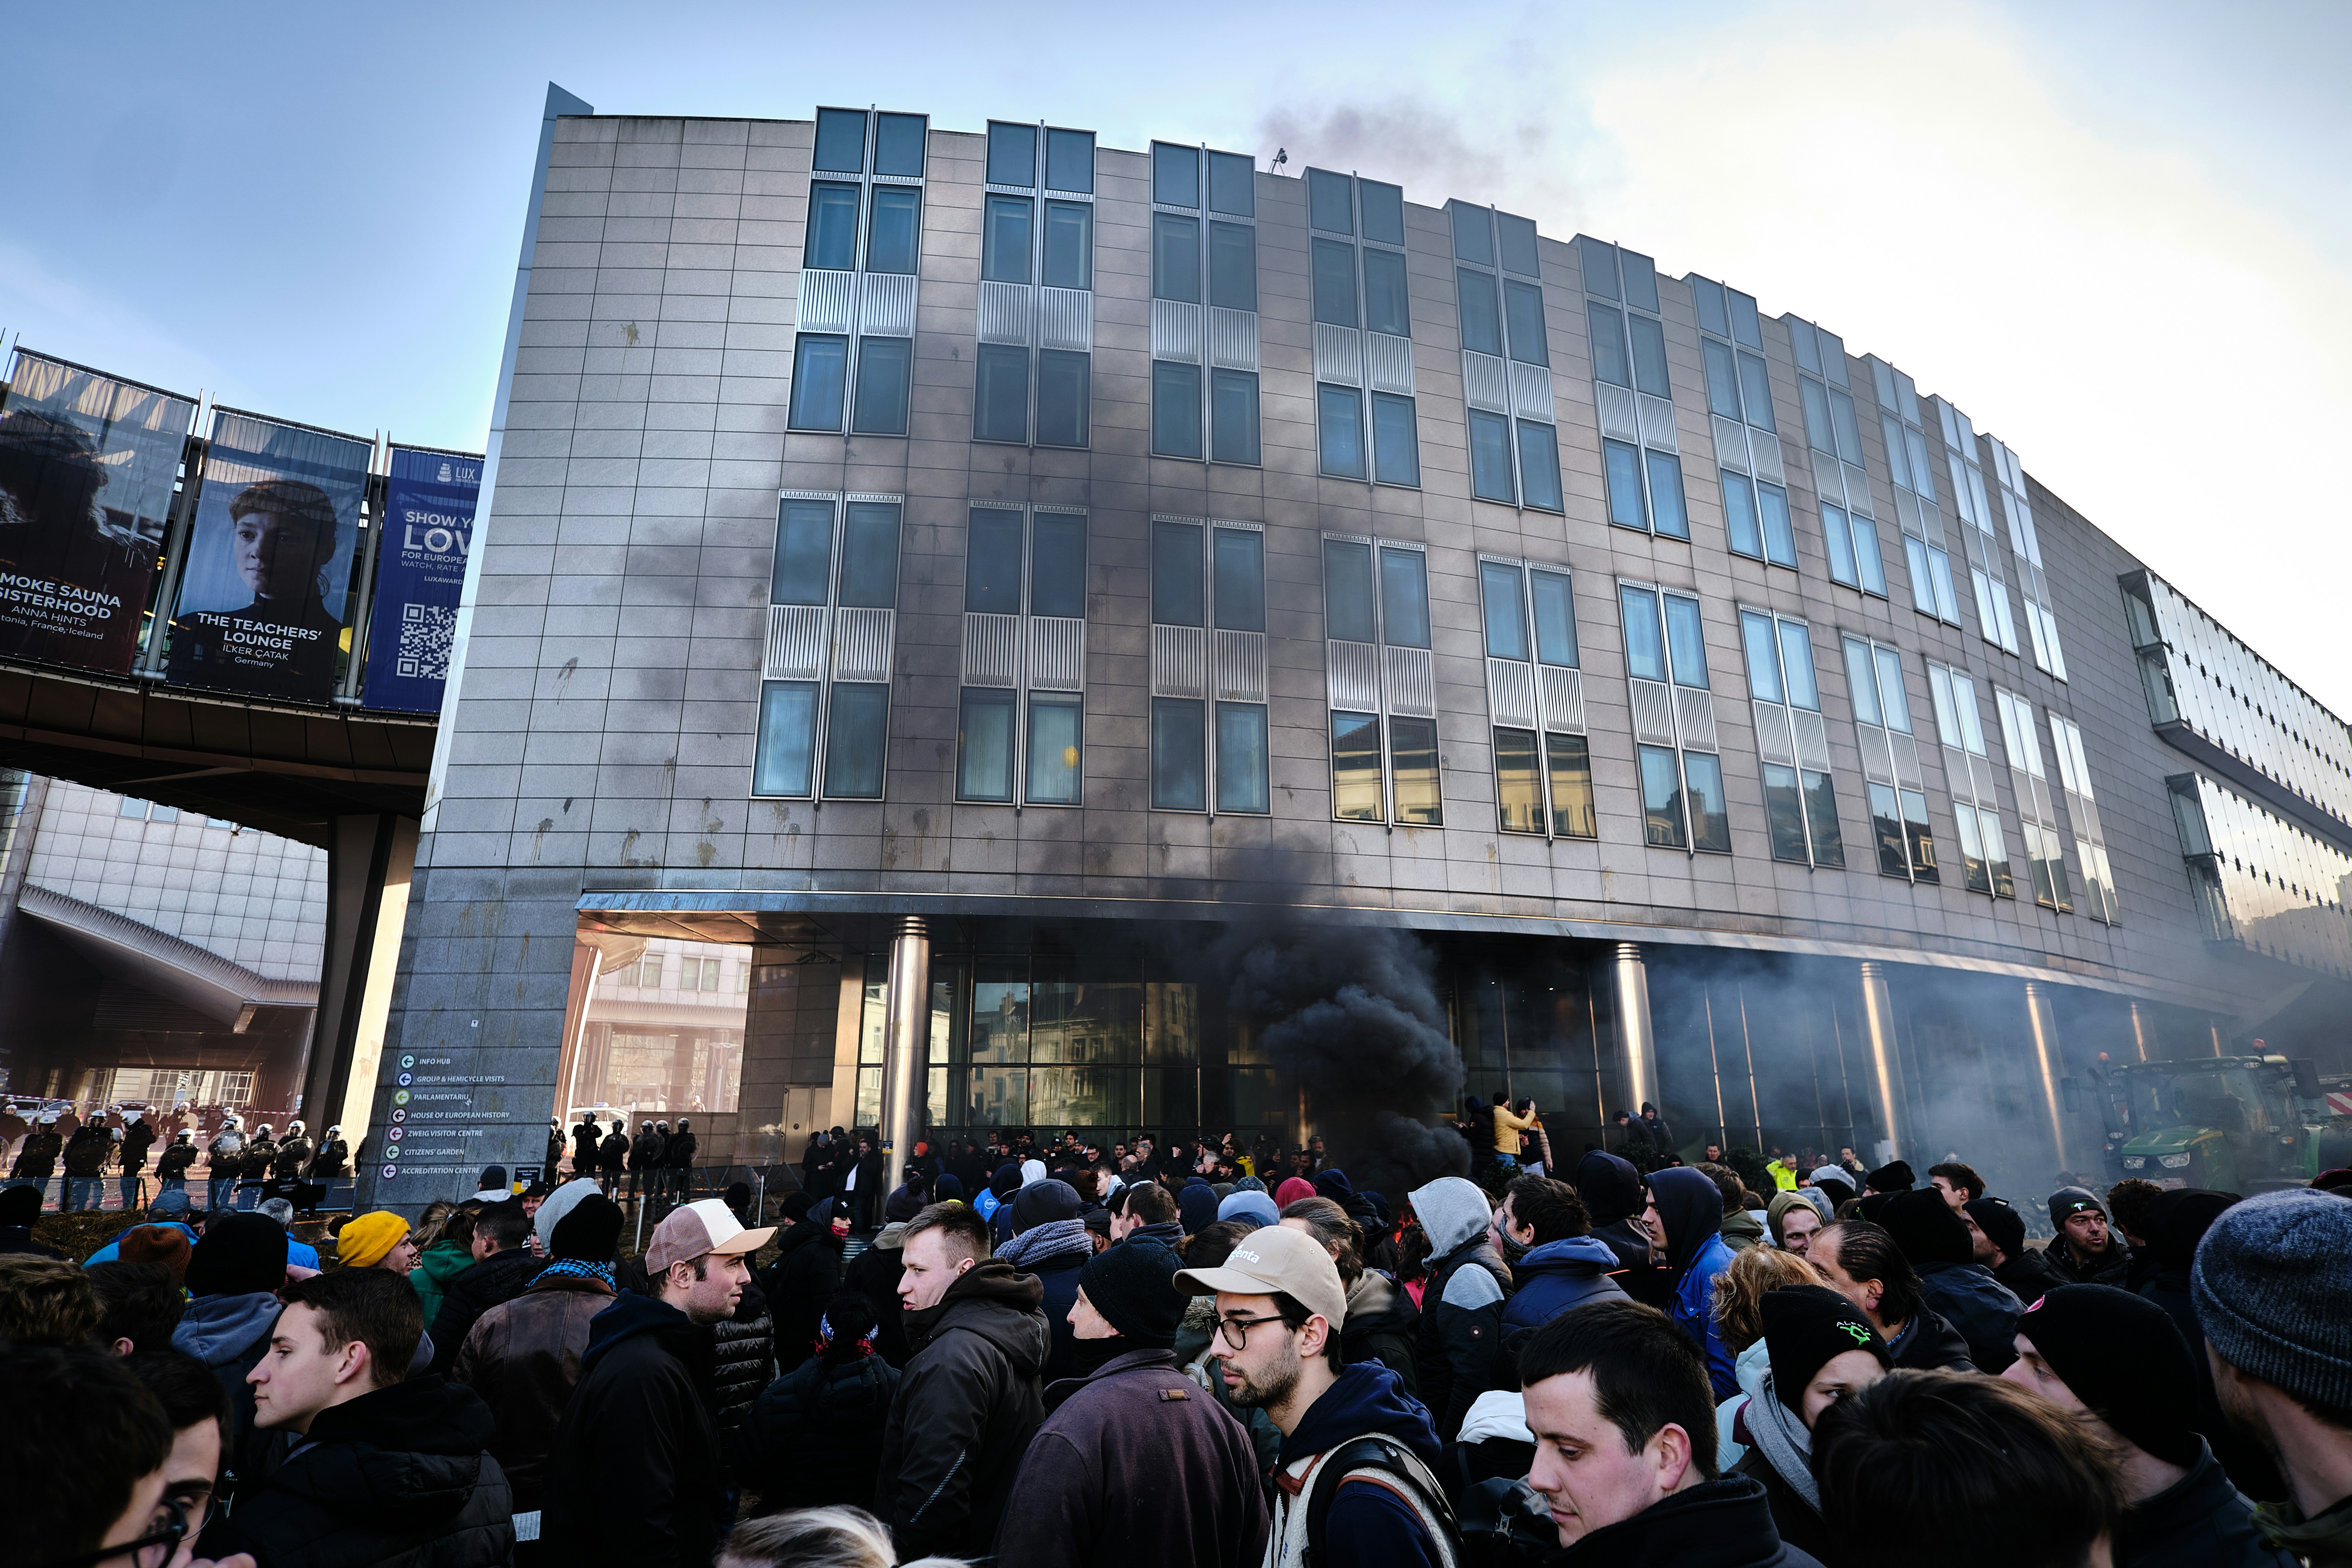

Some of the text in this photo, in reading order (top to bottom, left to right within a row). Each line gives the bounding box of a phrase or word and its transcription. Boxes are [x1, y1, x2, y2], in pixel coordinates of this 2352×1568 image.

[456, 467, 475, 479] LUX
[406, 511, 474, 528] SHOW Y
[402, 551, 421, 559] FOR
[401, 560, 433, 571] WATCH,
[437, 564, 458, 572] RATE
[0, 573, 121, 608] MOKE SAUNA
[11, 606, 87, 626] ANNA HINTS
[0, 615, 103, 640] tonia, France, Iceland
[198, 612, 322, 640] THE TEACHERS'
[224, 631, 292, 650] LOUNGE
[223, 644, 289, 661] ILKER ÇATAK
[235, 657, 274, 668] Germany
[1228, 1249, 1260, 1264] genta
